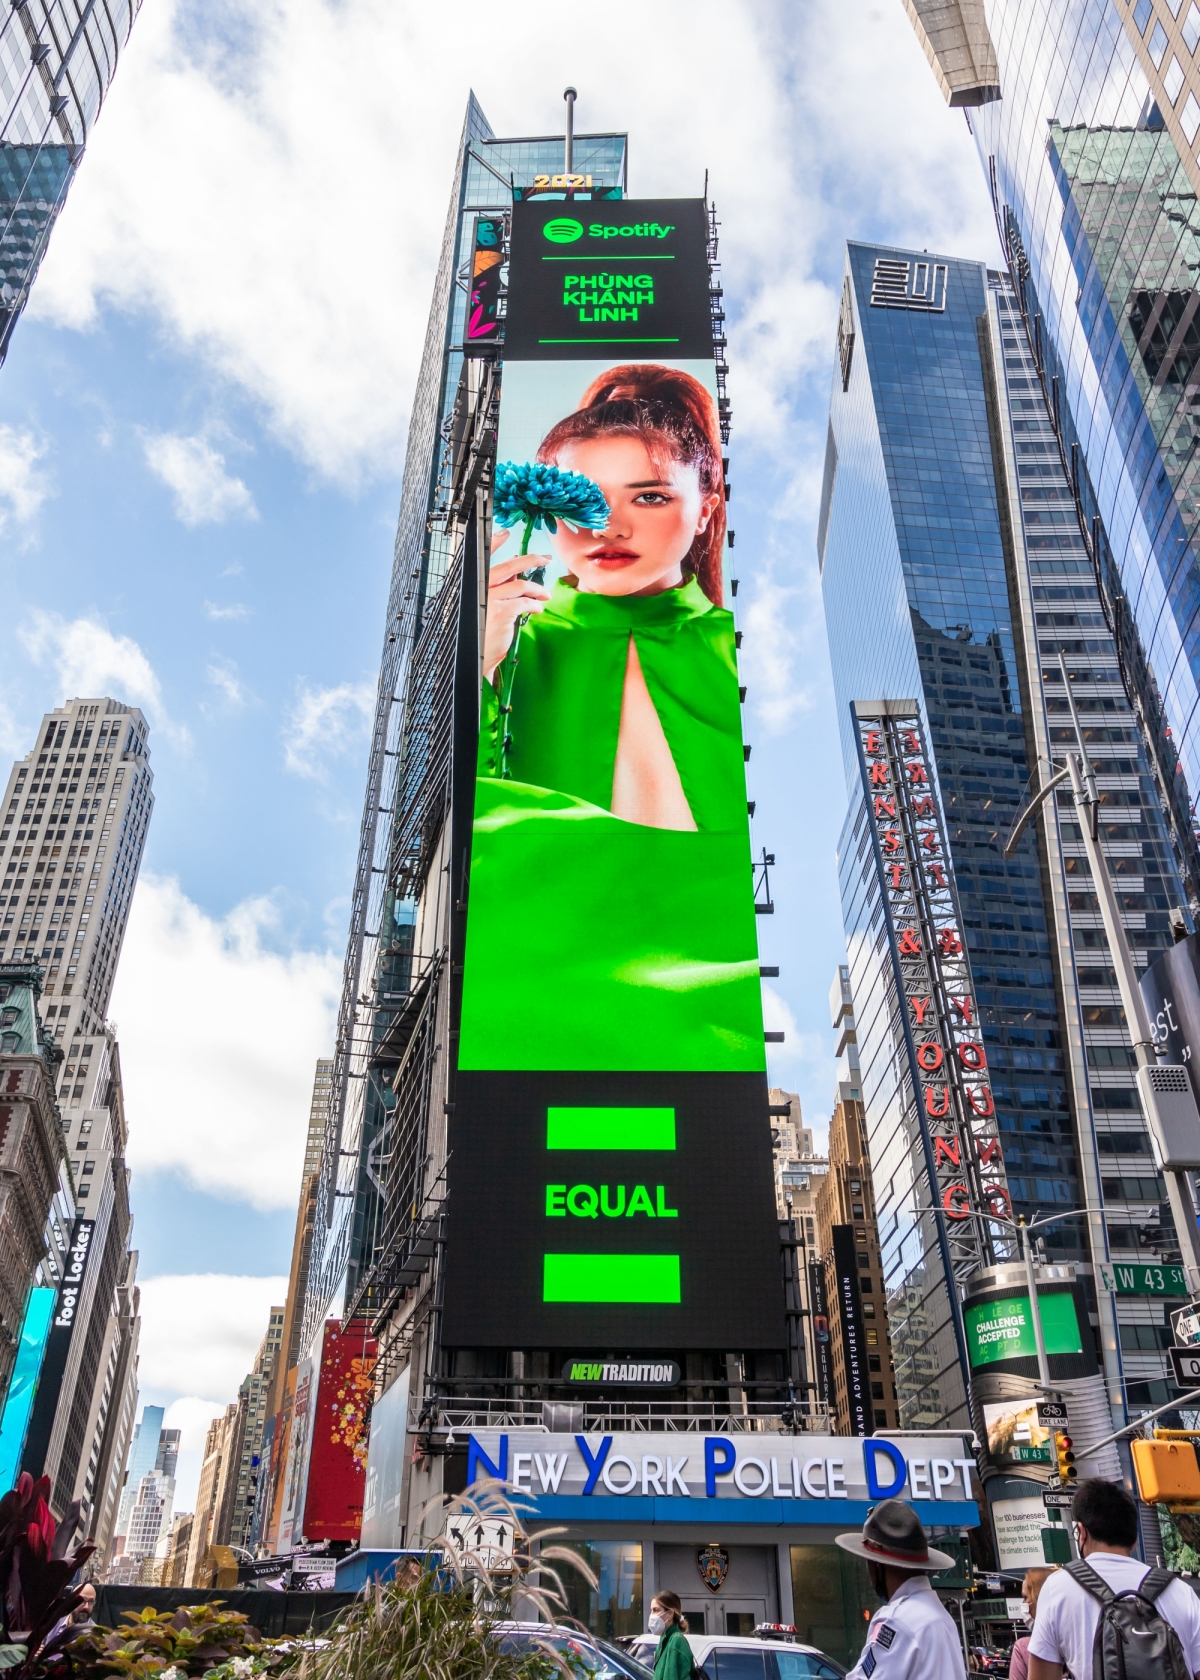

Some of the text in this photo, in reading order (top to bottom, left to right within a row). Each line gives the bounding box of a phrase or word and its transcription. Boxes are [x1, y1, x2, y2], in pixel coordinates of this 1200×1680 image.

[534, 175, 593, 187] 2021
[588, 223, 673, 239] Spotify
[564, 273, 654, 289] PHÙNG
[563, 289, 655, 306] KHÁNH
[579, 307, 638, 322] LINH
[867, 731, 905, 889] ERNST
[910, 997, 970, 1219] YOUNG
[545, 1184, 679, 1219] EQUAL
[1117, 1267, 1184, 1290] W 43 St
[814, 1267, 822, 1312] TIMES
[843, 1277, 854, 1318] RETURN
[55, 1287, 79, 1327] Foot
[976, 1315, 1026, 1334] CHALLENGE
[1180, 1320, 1194, 1337] ONE
[978, 1328, 1021, 1345] ACCEPTED
[848, 1325, 862, 1399] ADVENTURES
[1021, 1449, 1029, 1459] W
[1032, 1449, 1042, 1459] 43
[467, 1433, 977, 1499] NEW YORK POLICE DEPT
[1012, 1512, 1046, 1521] businesses
[1007, 1524, 1029, 1533] accepted
[1025, 1534, 1042, 1542] tackl
[254, 1566, 281, 1575] VOLVO
